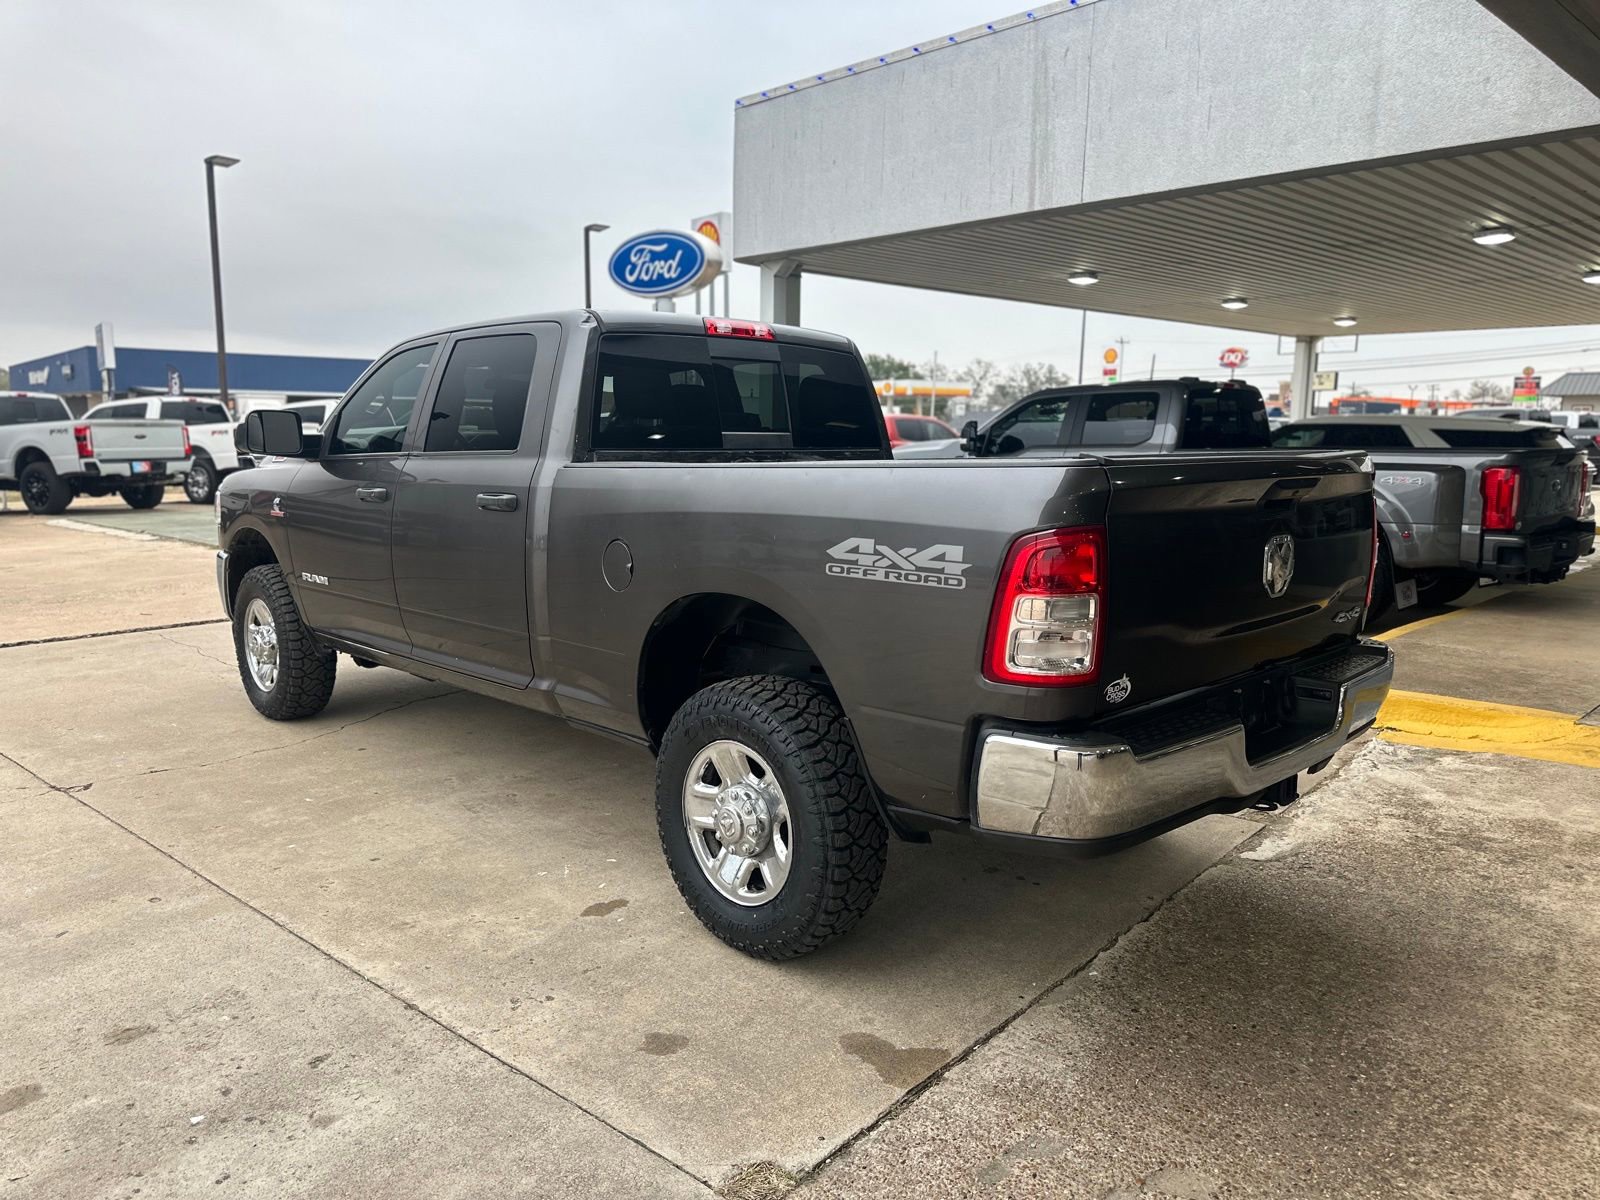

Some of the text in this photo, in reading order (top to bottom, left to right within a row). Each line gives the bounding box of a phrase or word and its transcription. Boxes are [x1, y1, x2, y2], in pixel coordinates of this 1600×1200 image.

[625, 243, 682, 283] Ford
[1223, 352, 1242, 363] DQ
[301, 571, 329, 586] RAM
[828, 564, 963, 587] OFF ROAD
[1106, 689, 1126, 702] CROSS
[1107, 685, 1120, 694] BUD
